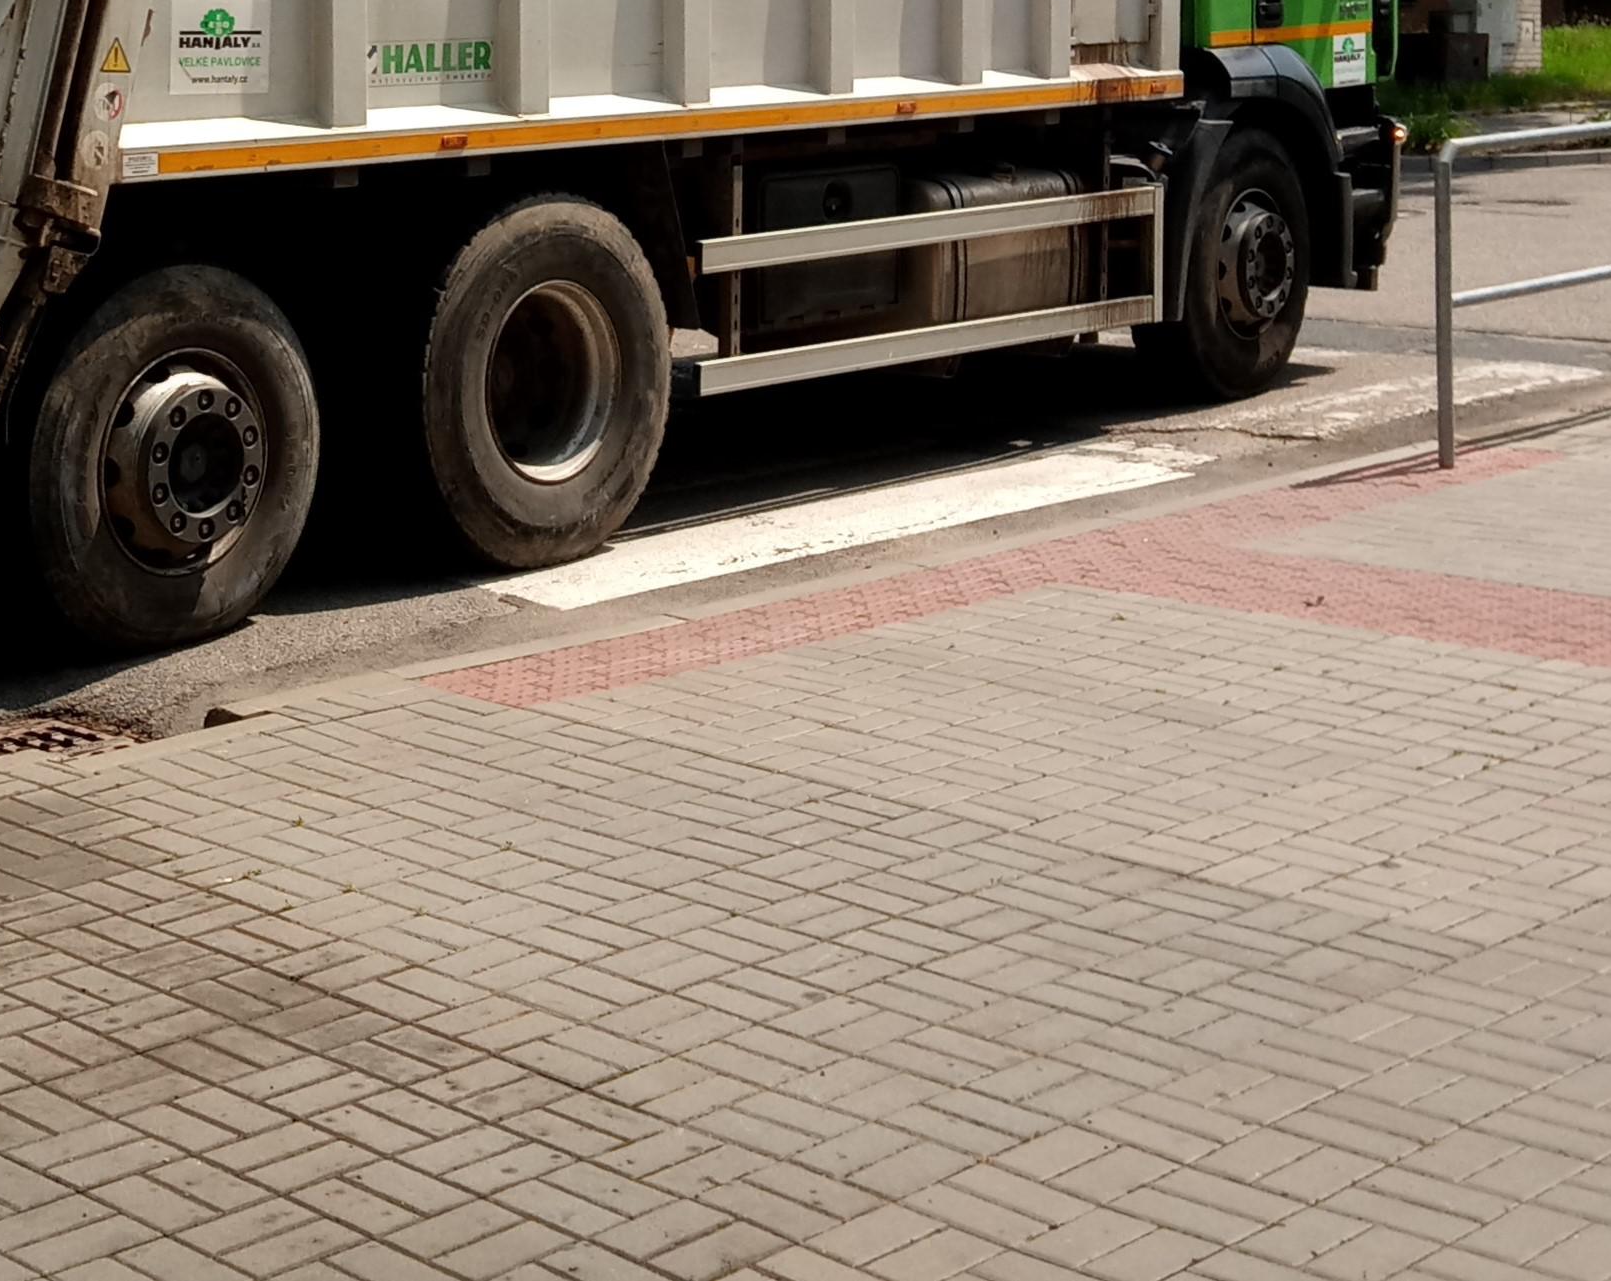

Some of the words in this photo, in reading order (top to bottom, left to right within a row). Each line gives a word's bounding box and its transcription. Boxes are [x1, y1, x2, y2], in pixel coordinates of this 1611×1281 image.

[211, 56, 261, 67] PAVLOVICE
[382, 41, 492, 74] HALLER
[191, 75, 249, 85] www.hantaly.cz
